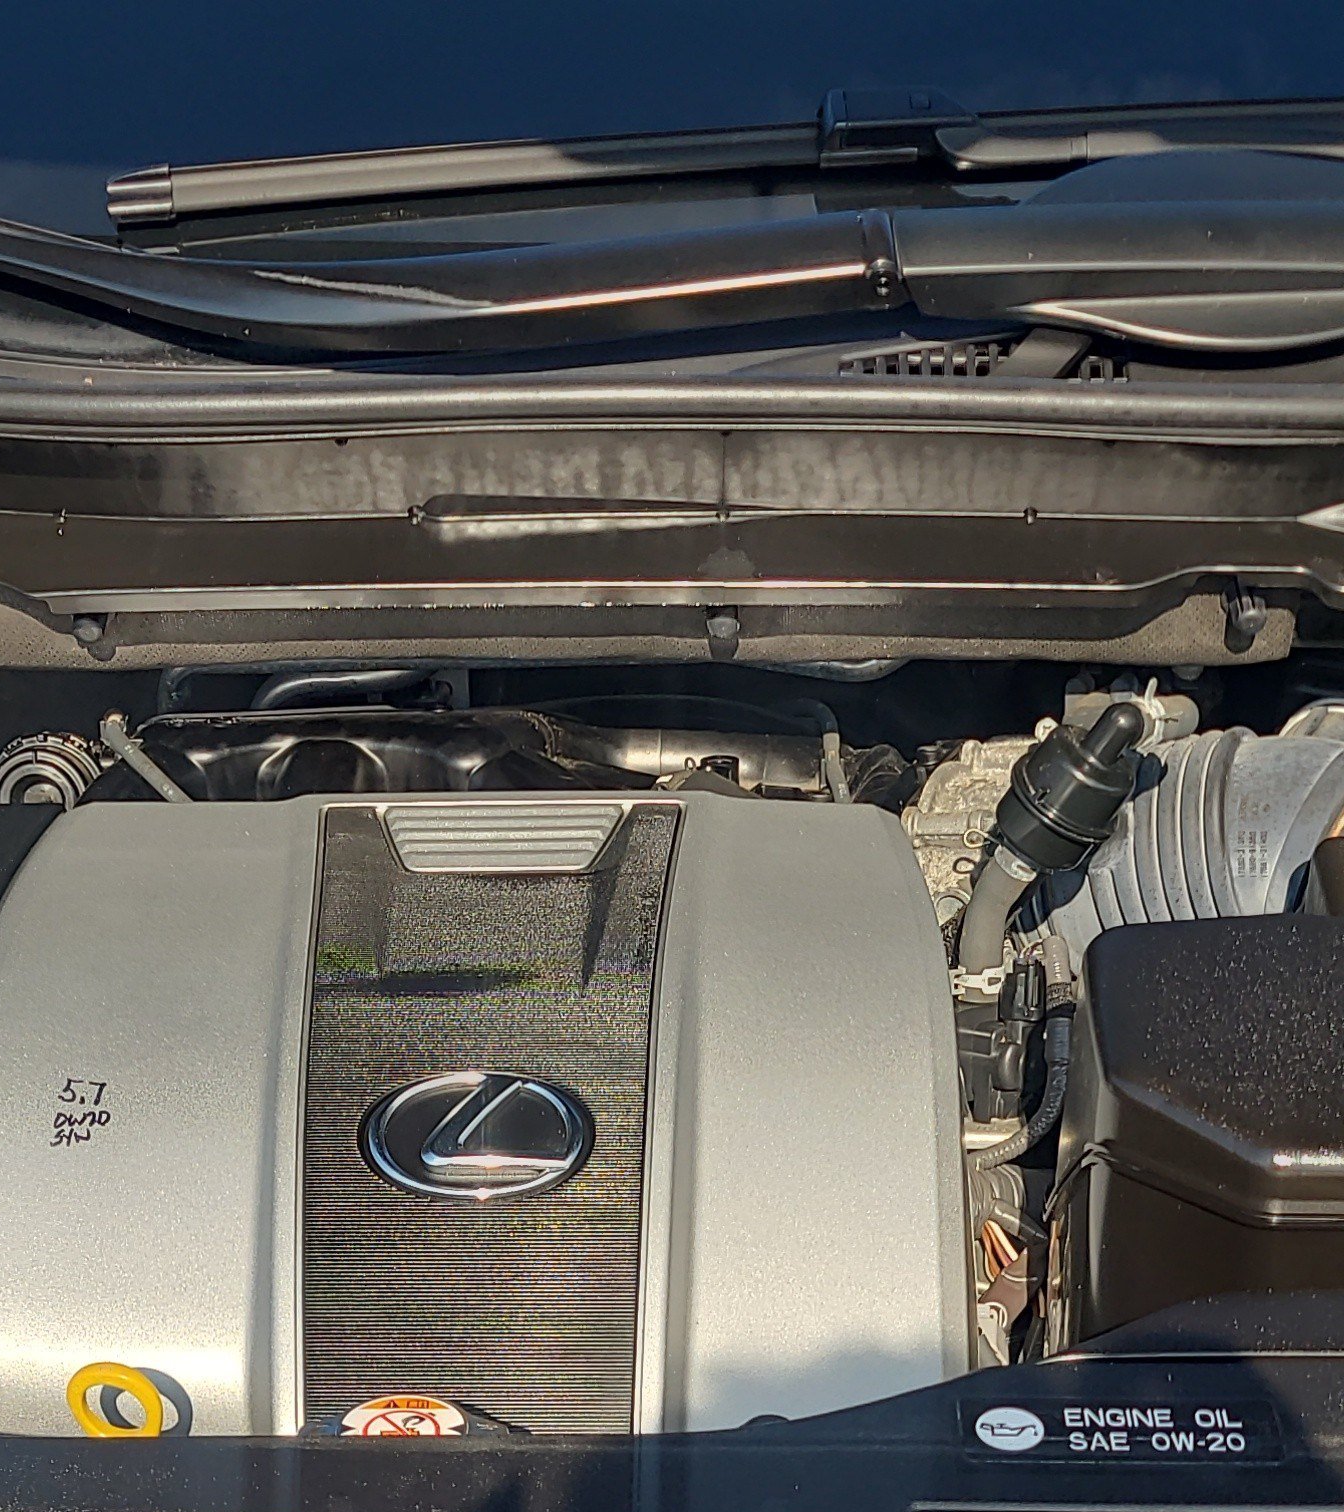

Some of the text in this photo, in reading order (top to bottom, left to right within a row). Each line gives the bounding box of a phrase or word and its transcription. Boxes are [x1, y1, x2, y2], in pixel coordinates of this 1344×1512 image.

[57, 1077, 107, 1106] 5.7
[1063, 1407, 1244, 1429] ENGINE OIL
[1068, 1431, 1246, 1453] SAE 0W-20
